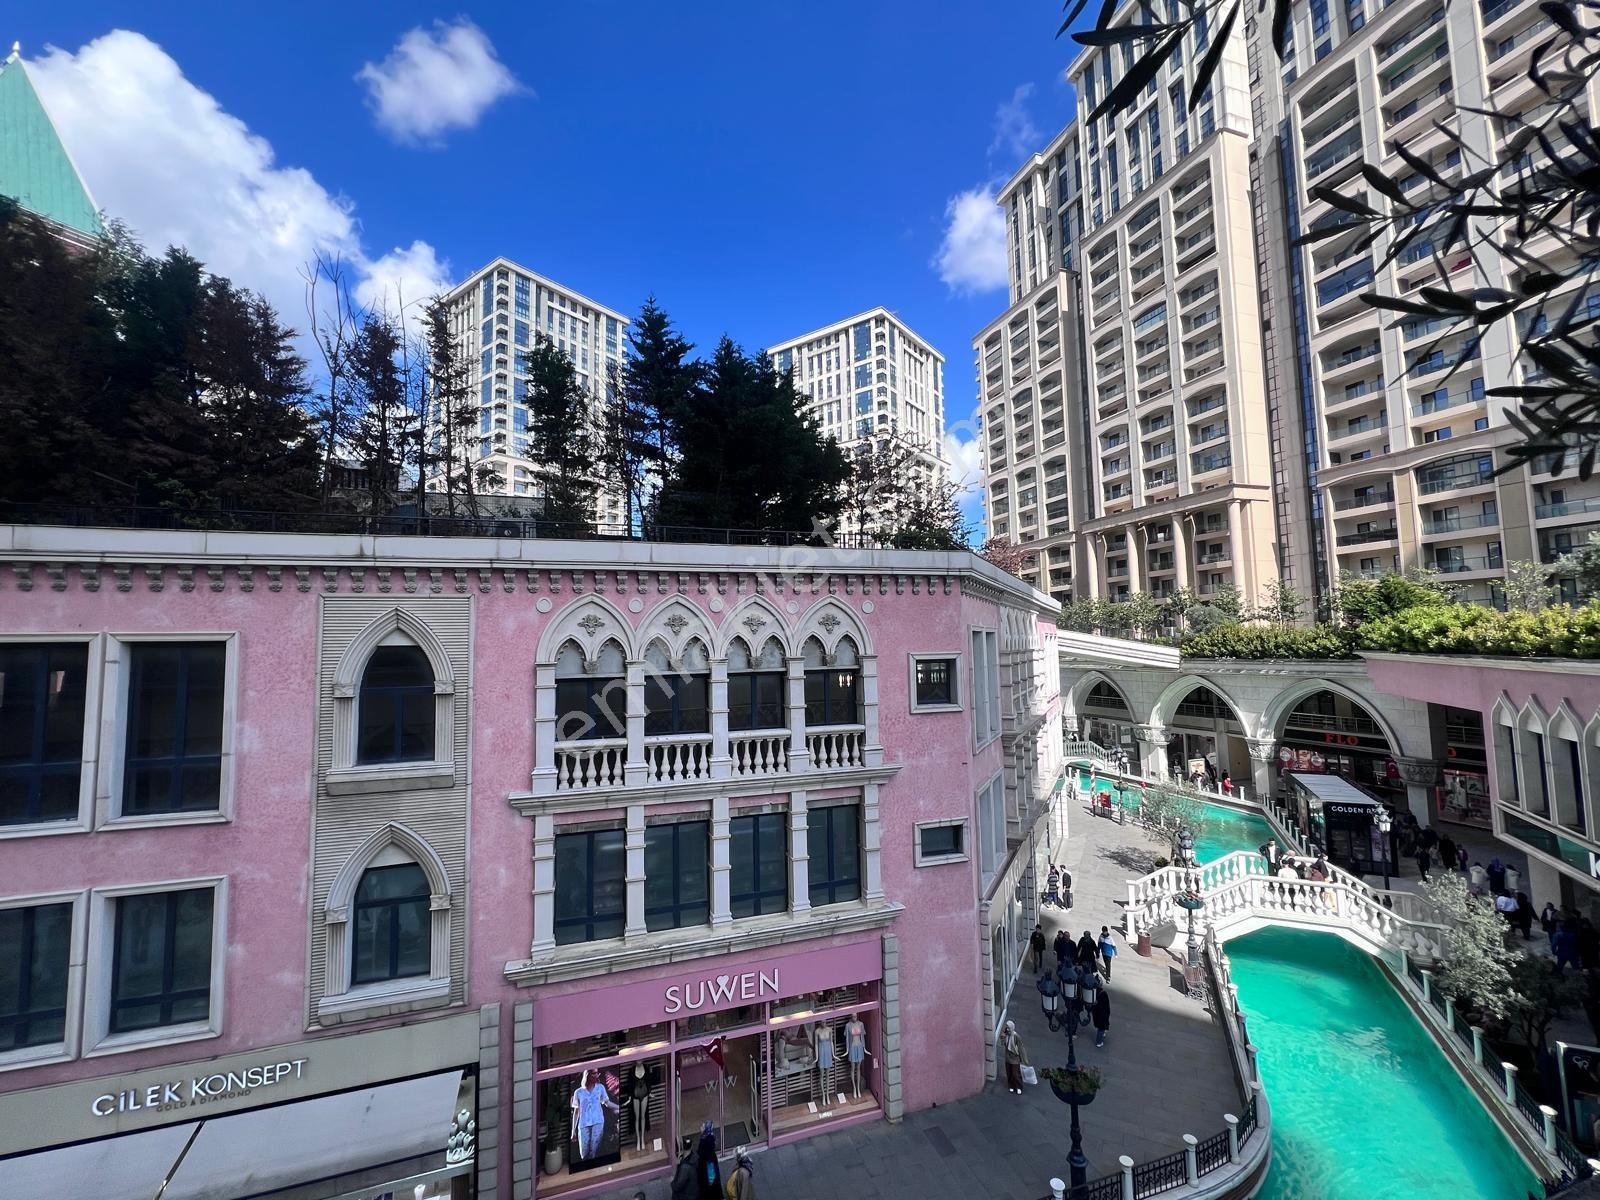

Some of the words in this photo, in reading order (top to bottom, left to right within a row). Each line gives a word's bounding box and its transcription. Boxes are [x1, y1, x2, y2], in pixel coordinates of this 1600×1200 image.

[1325, 734, 1358, 746] FLO
[665, 968, 779, 1013] SUWEN
[191, 1058, 308, 1098] KONSEPT
[156, 1102, 187, 1112] GOLD
[200, 1089, 251, 1104] DIAMOND
